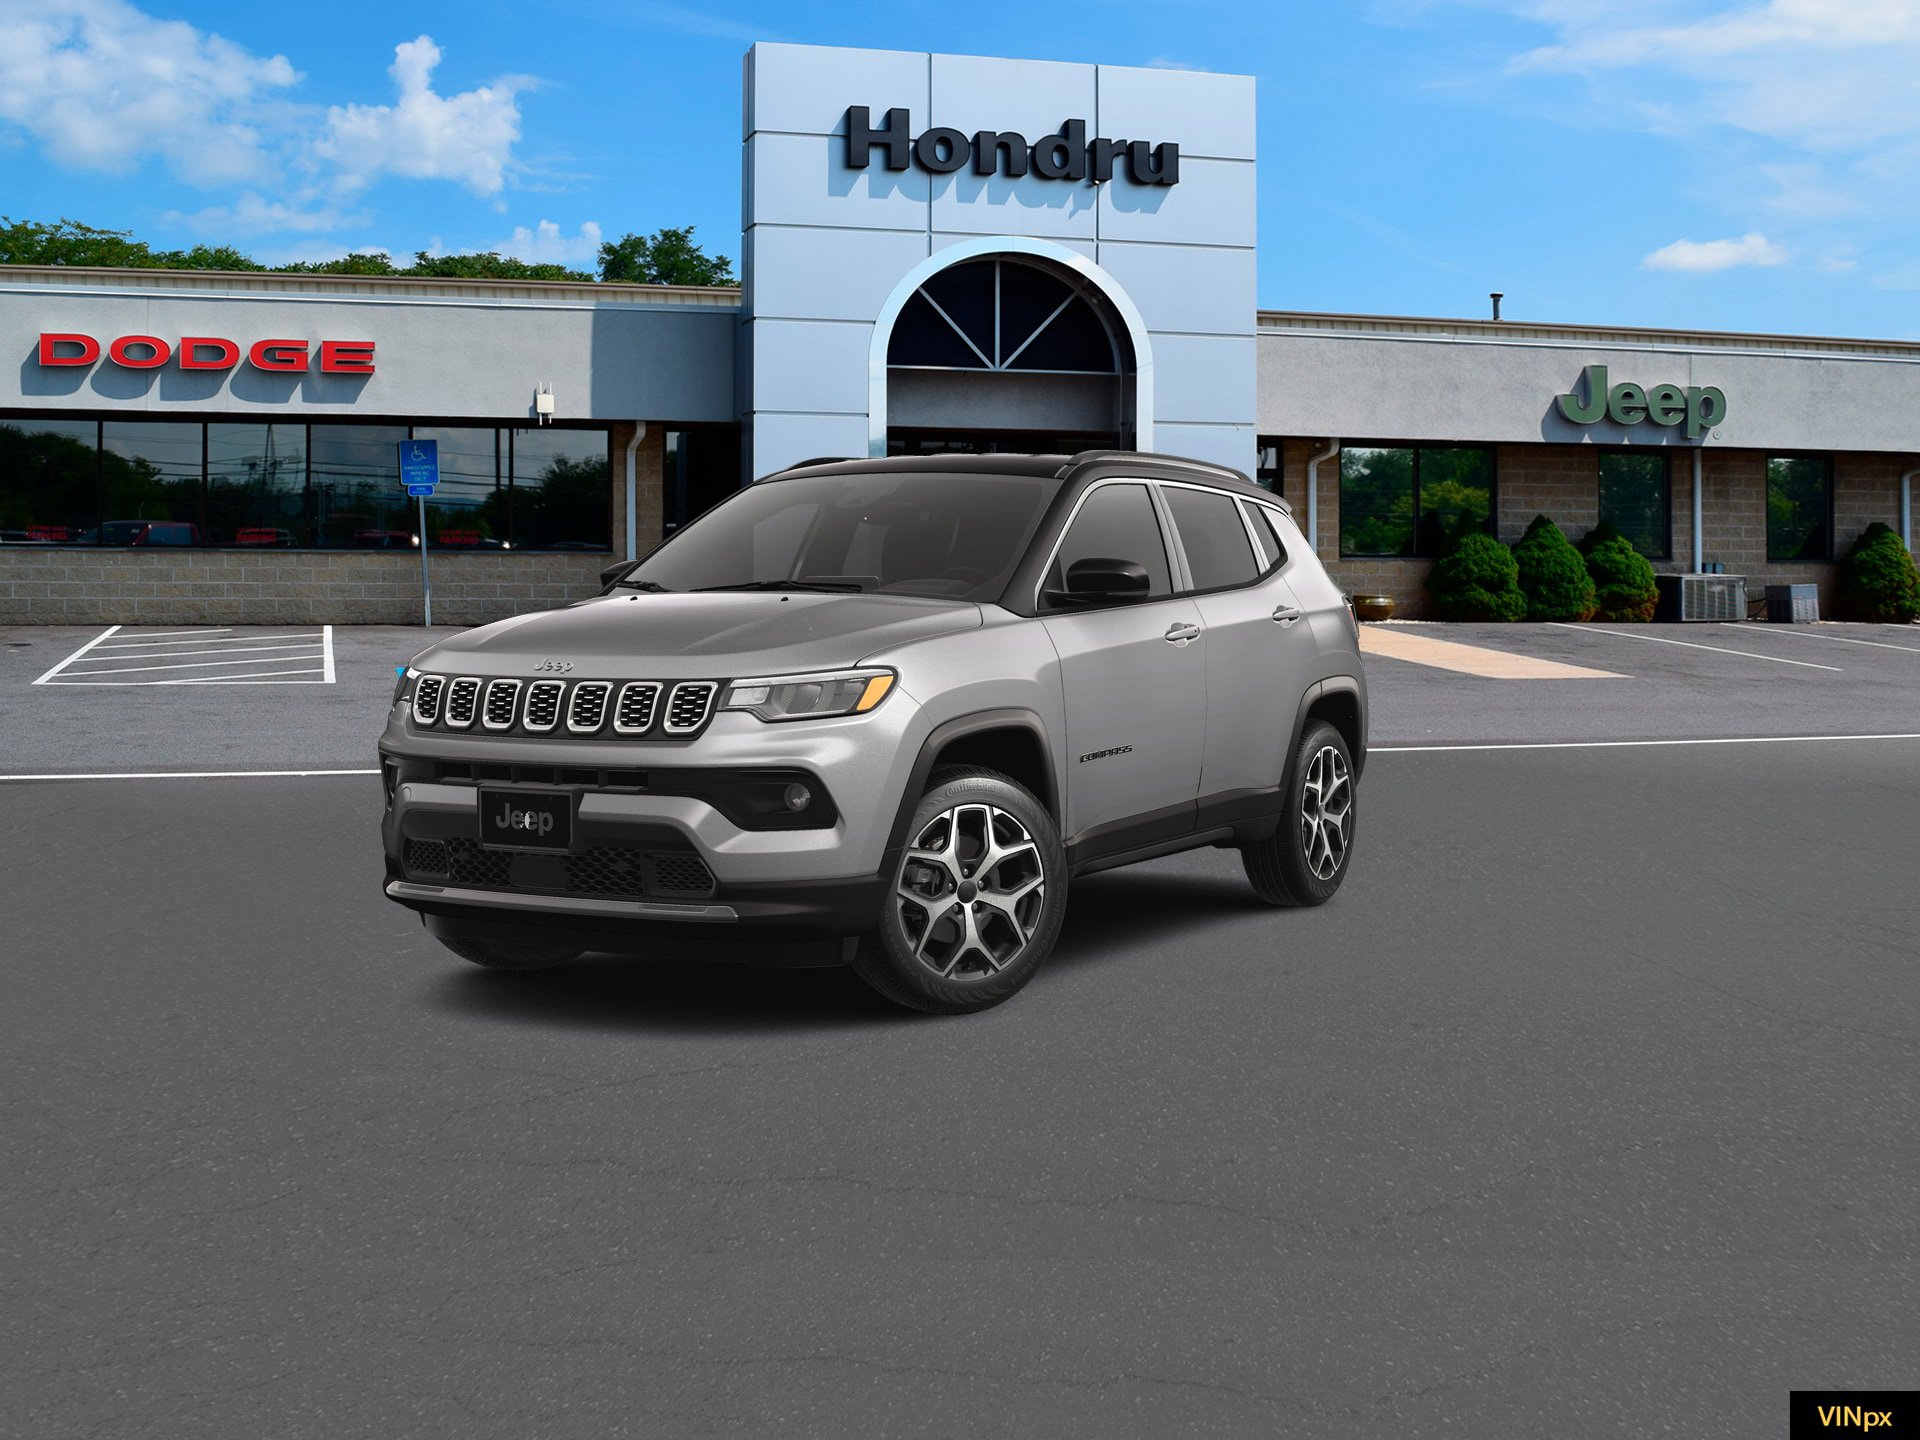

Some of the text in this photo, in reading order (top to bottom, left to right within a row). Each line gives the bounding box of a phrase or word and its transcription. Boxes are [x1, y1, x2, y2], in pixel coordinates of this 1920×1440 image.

[846, 104, 1180, 186] Hondru
[39, 332, 376, 374] DODGE
[1556, 364, 1727, 440] Jeep
[533, 658, 574, 674] Jeep
[1079, 744, 1132, 763] COMPASS
[495, 802, 554, 836] Jeep
